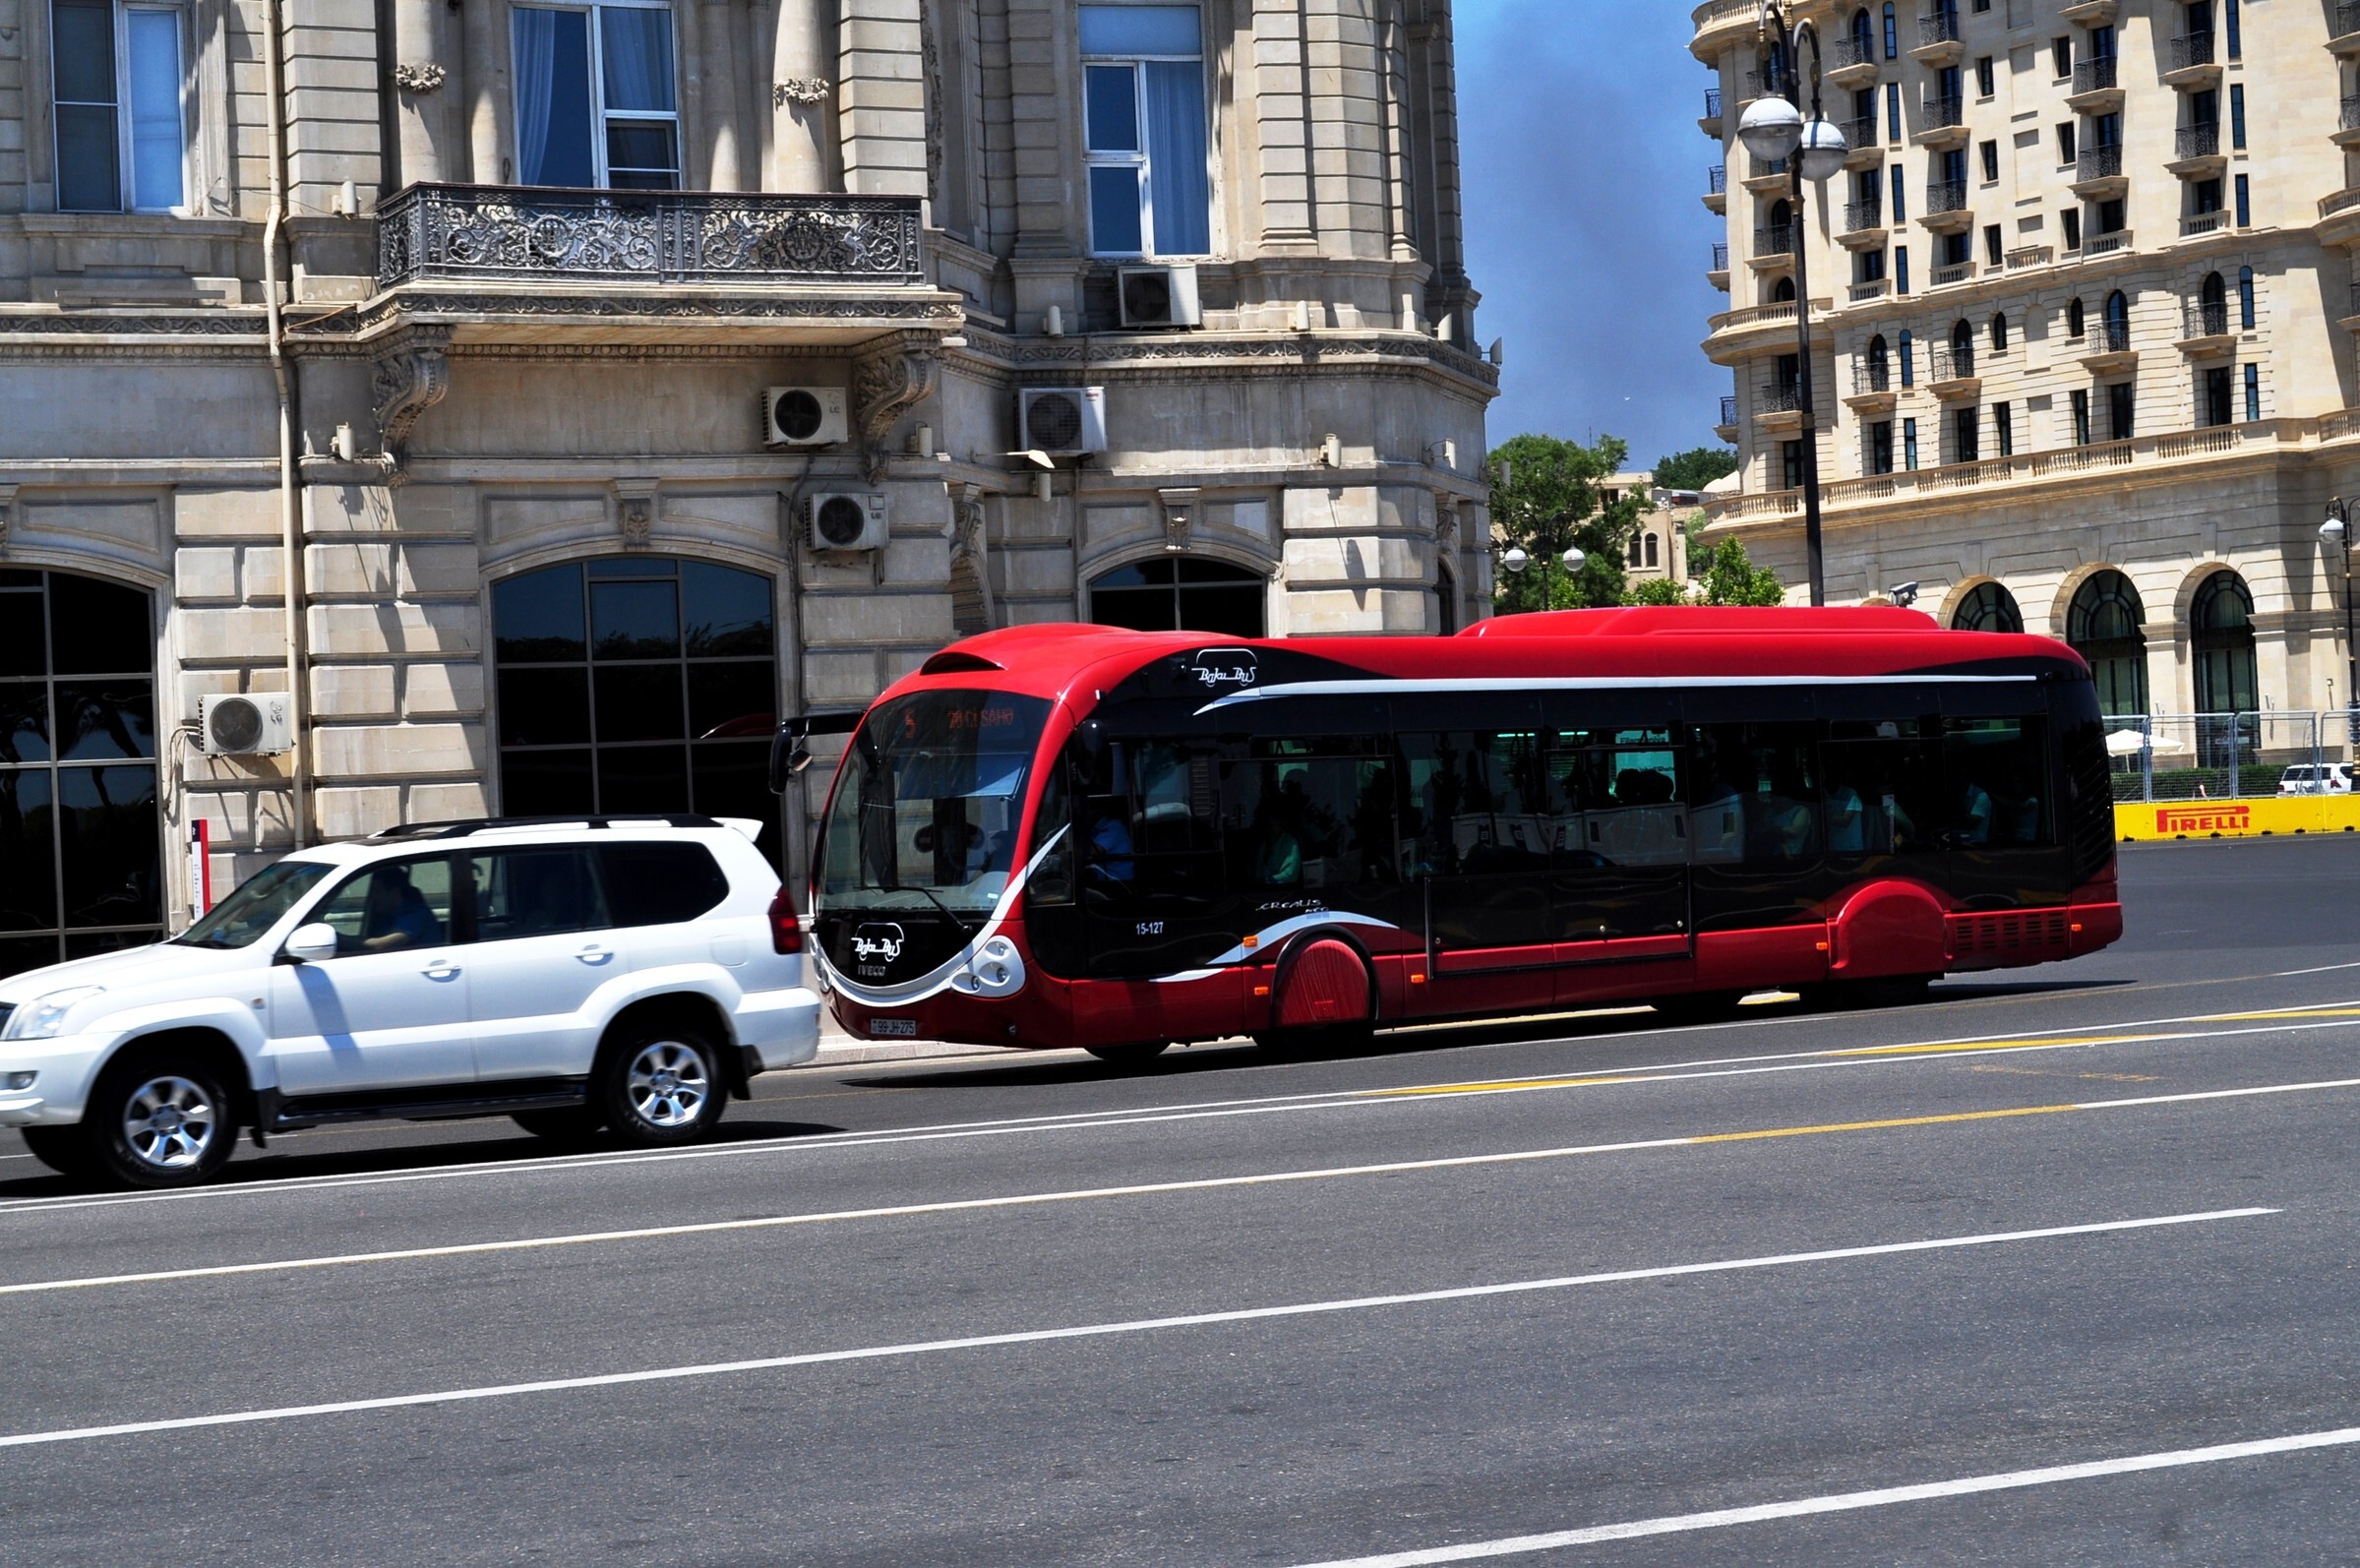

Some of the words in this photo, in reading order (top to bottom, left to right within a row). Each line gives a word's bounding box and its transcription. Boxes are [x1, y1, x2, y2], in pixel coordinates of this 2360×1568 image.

[2156, 806, 2250, 832] PIRELLI
[1135, 921, 1164, 935] 15-127
[858, 964, 885, 977] IVECO
